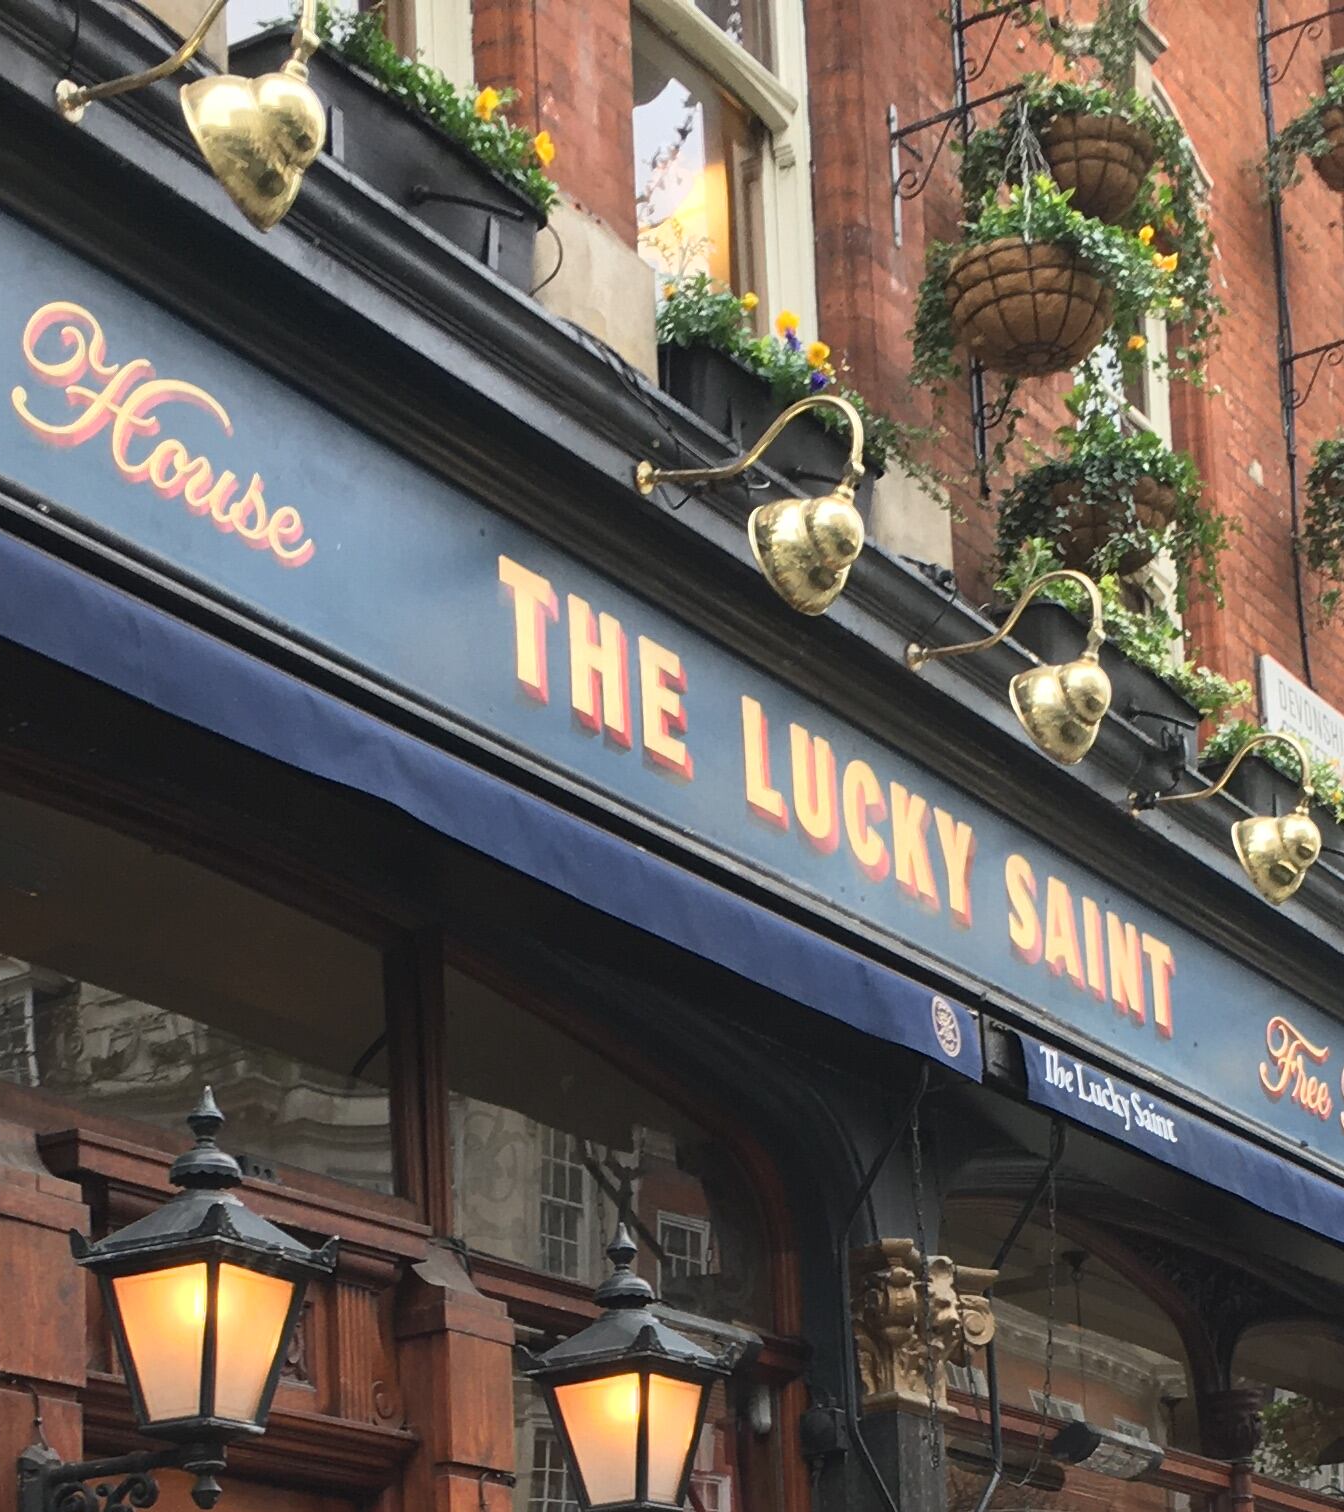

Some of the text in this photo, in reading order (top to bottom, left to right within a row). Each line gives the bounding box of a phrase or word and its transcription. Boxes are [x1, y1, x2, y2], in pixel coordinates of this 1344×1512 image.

[11, 301, 315, 567] House
[498, 554, 1176, 1039] THE LUCKY SAINT
[1040, 1045, 1177, 1142] The Lucky Saint
[1260, 1016, 1332, 1120] Free
